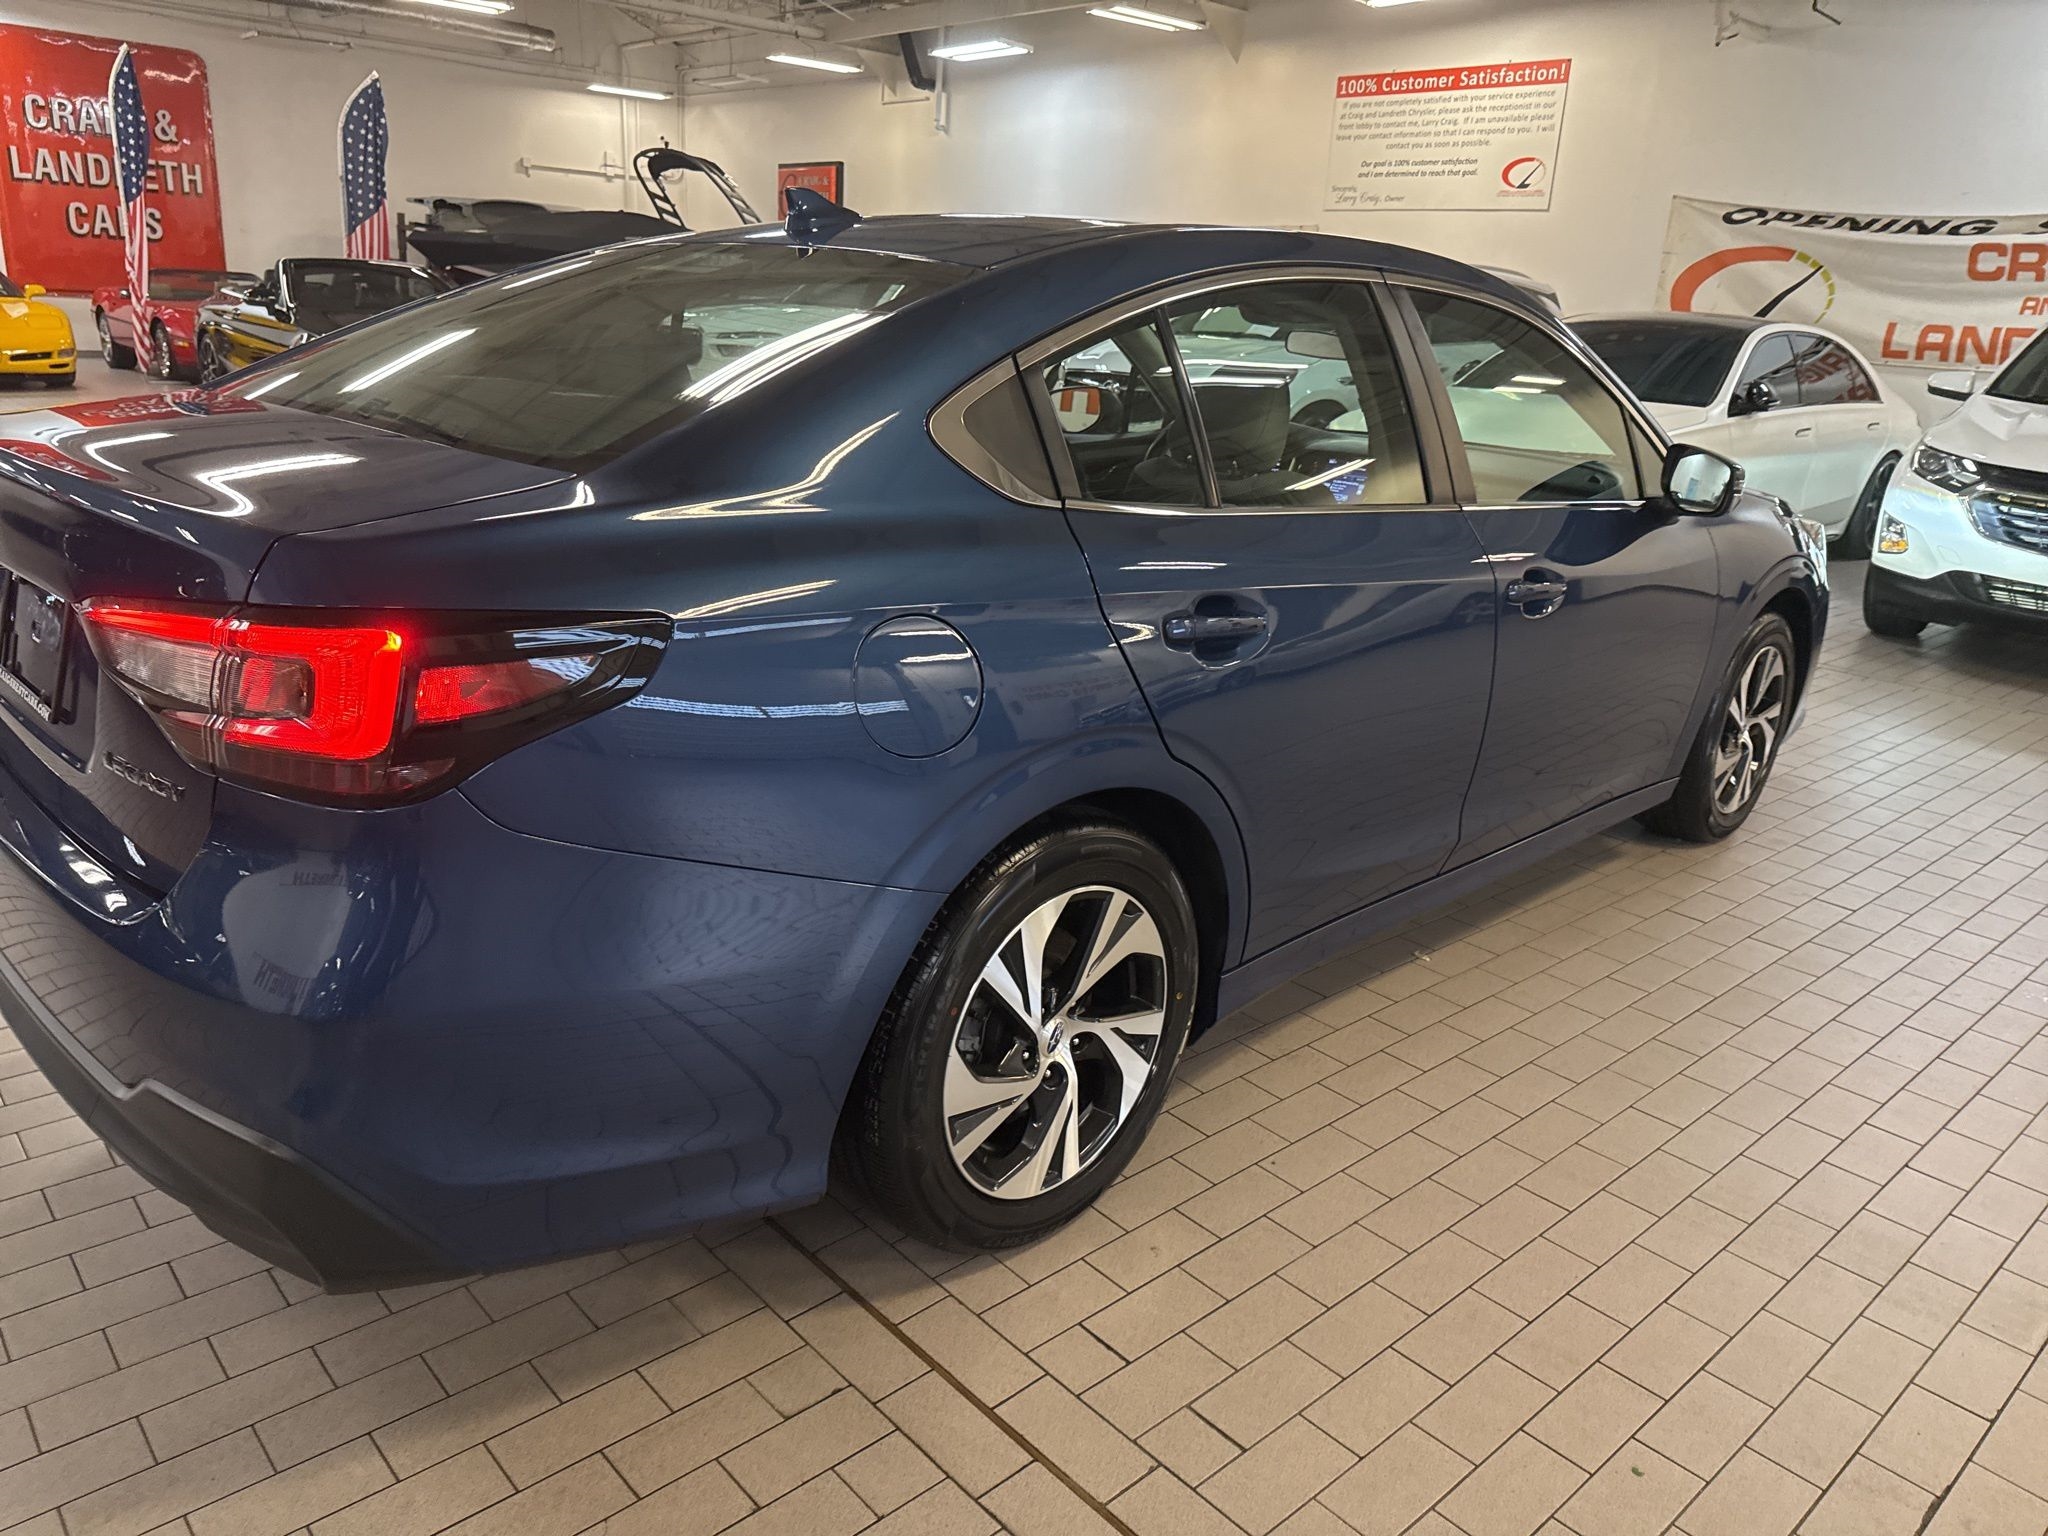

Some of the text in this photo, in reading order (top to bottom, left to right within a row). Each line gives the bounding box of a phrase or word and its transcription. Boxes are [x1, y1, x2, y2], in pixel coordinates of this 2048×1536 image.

[1339, 63, 1566, 95] 100% Customer Satisfaction!
[1386, 98, 1421, 107] completely
[1423, 94, 1451, 104] satisfied
[1453, 94, 1468, 102] with
[1470, 95, 1486, 103] your
[1488, 91, 1513, 100] service
[1515, 90, 1556, 101] experience
[24, 93, 178, 143] CRAI &
[1348, 111, 1363, 120] Craig
[1378, 108, 1407, 118] Landreth
[1438, 106, 1460, 115] please
[1476, 104, 1487, 112] the
[1489, 102, 1532, 112] receptionist
[1382, 120, 1406, 128] contact
[1422, 119, 1439, 128] Larry
[1488, 114, 1529, 123] unavailable
[1530, 113, 1555, 122] please
[1353, 134, 1368, 142] your
[1368, 132, 1392, 140] contact
[1394, 130, 1432, 139] information
[1443, 128, 1457, 136] that
[1462, 128, 1476, 136] can
[1476, 126, 1506, 136] respond
[1507, 126, 1515, 134] to
[1386, 142, 1410, 150] contact
[1412, 142, 1424, 150] you
[1452, 140, 1460, 148] as
[9, 146, 204, 194] LANDETH
[1360, 160, 1373, 168] Our
[1374, 159, 1388, 168] goal
[1394, 159, 1410, 167] 100%
[1441, 157, 1478, 166] satisfaction
[1384, 170, 1420, 178] determined
[1428, 169, 1445, 177] reach
[1446, 168, 1461, 176] that
[1722, 207, 1998, 236] OPENING
